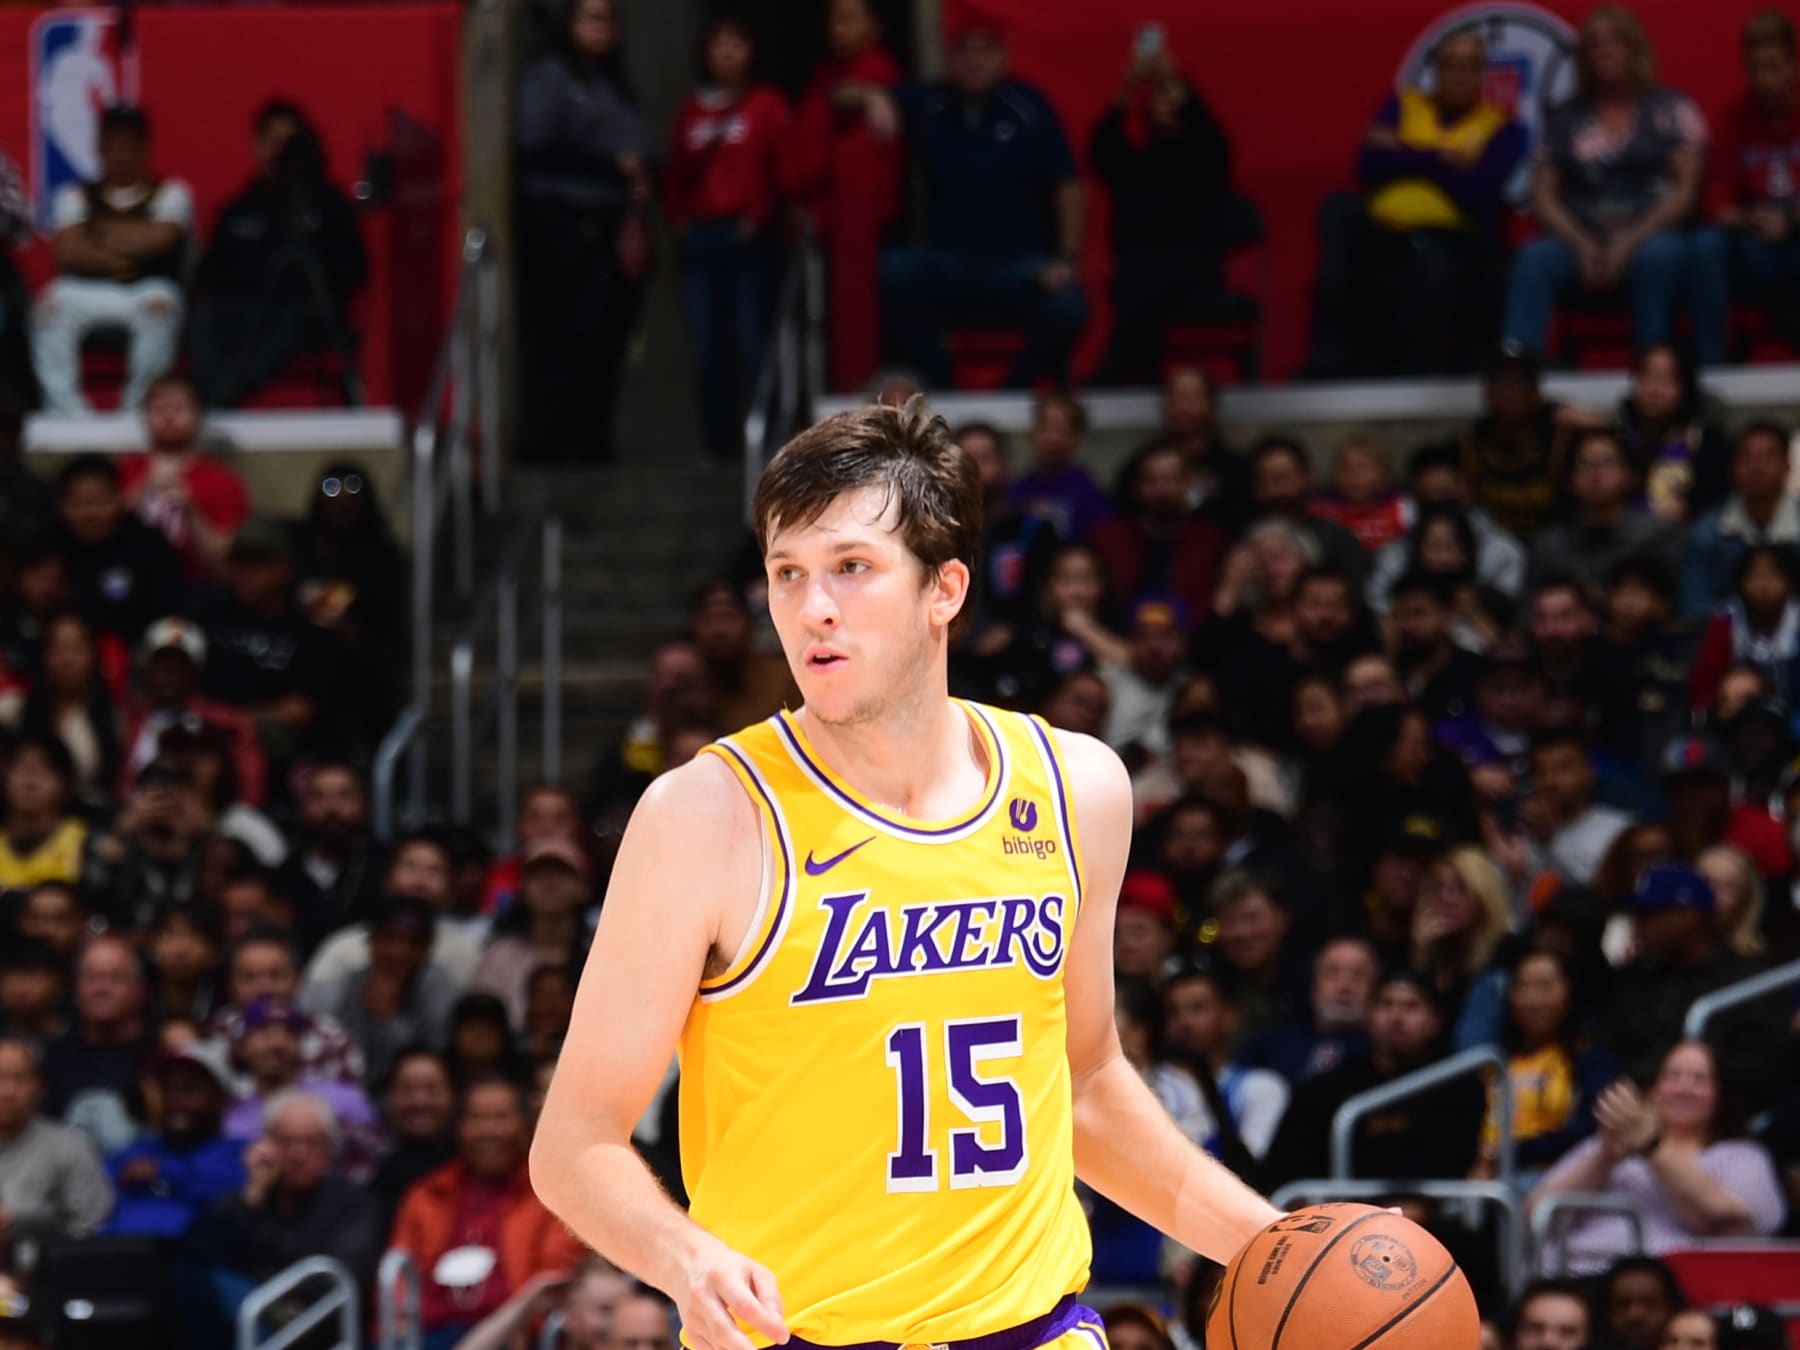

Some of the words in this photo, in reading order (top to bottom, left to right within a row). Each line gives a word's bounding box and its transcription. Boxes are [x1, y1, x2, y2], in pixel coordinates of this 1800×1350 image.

[1002, 836, 1056, 860] bibigo
[789, 887, 1066, 1007] LAKERS
[885, 1012, 1029, 1193] 15
